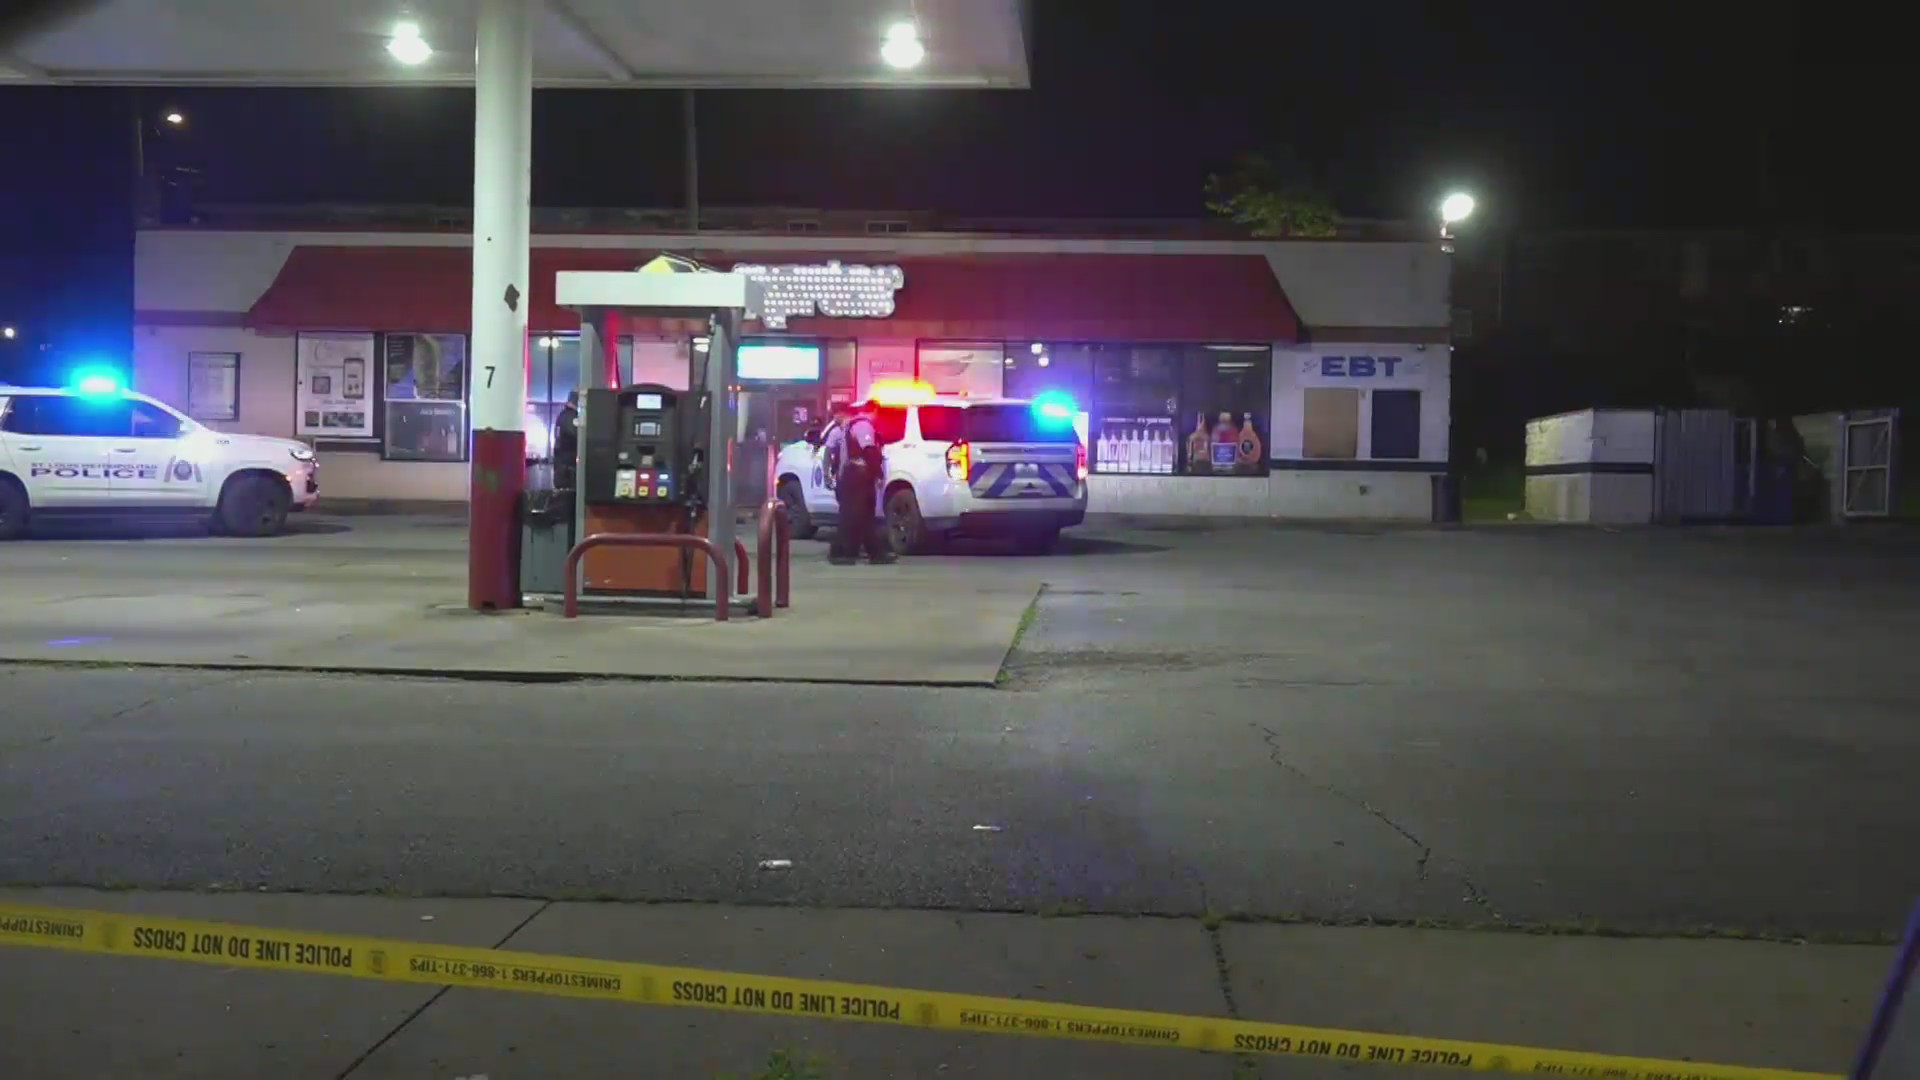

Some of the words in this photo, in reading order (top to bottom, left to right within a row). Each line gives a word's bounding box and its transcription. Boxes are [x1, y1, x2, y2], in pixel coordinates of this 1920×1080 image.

[1321, 355, 1402, 376] EBT
[484, 365, 496, 389] 7
[31, 468, 157, 479] POLICE
[0, 918, 84, 937] CRIMESTOPP
[133, 927, 186, 951] CROSS
[191, 933, 224, 955] NOT
[228, 936, 250, 958] DO
[255, 939, 290, 963] LINE
[295, 943, 353, 968] POLICE
[409, 958, 507, 980] 1-866-371-TIPS
[512, 968, 621, 991] CRIMESTOPPERS
[672, 981, 727, 1004] CROSS
[735, 987, 765, 1009] NOT
[771, 990, 793, 1010] DO
[800, 993, 835, 1014] LINE
[841, 997, 900, 1020] POLICE
[959, 1011, 1062, 1031] 1-866-371-TIPS
[1067, 1021, 1180, 1042] CRIMESTOPPERS
[1233, 1033, 1291, 1052] CROSS
[1297, 1039, 1332, 1056] NOT
[1336, 1042, 1361, 1058] DO
[1367, 1045, 1406, 1063] LINE
[1411, 1049, 1473, 1067] POLICE
